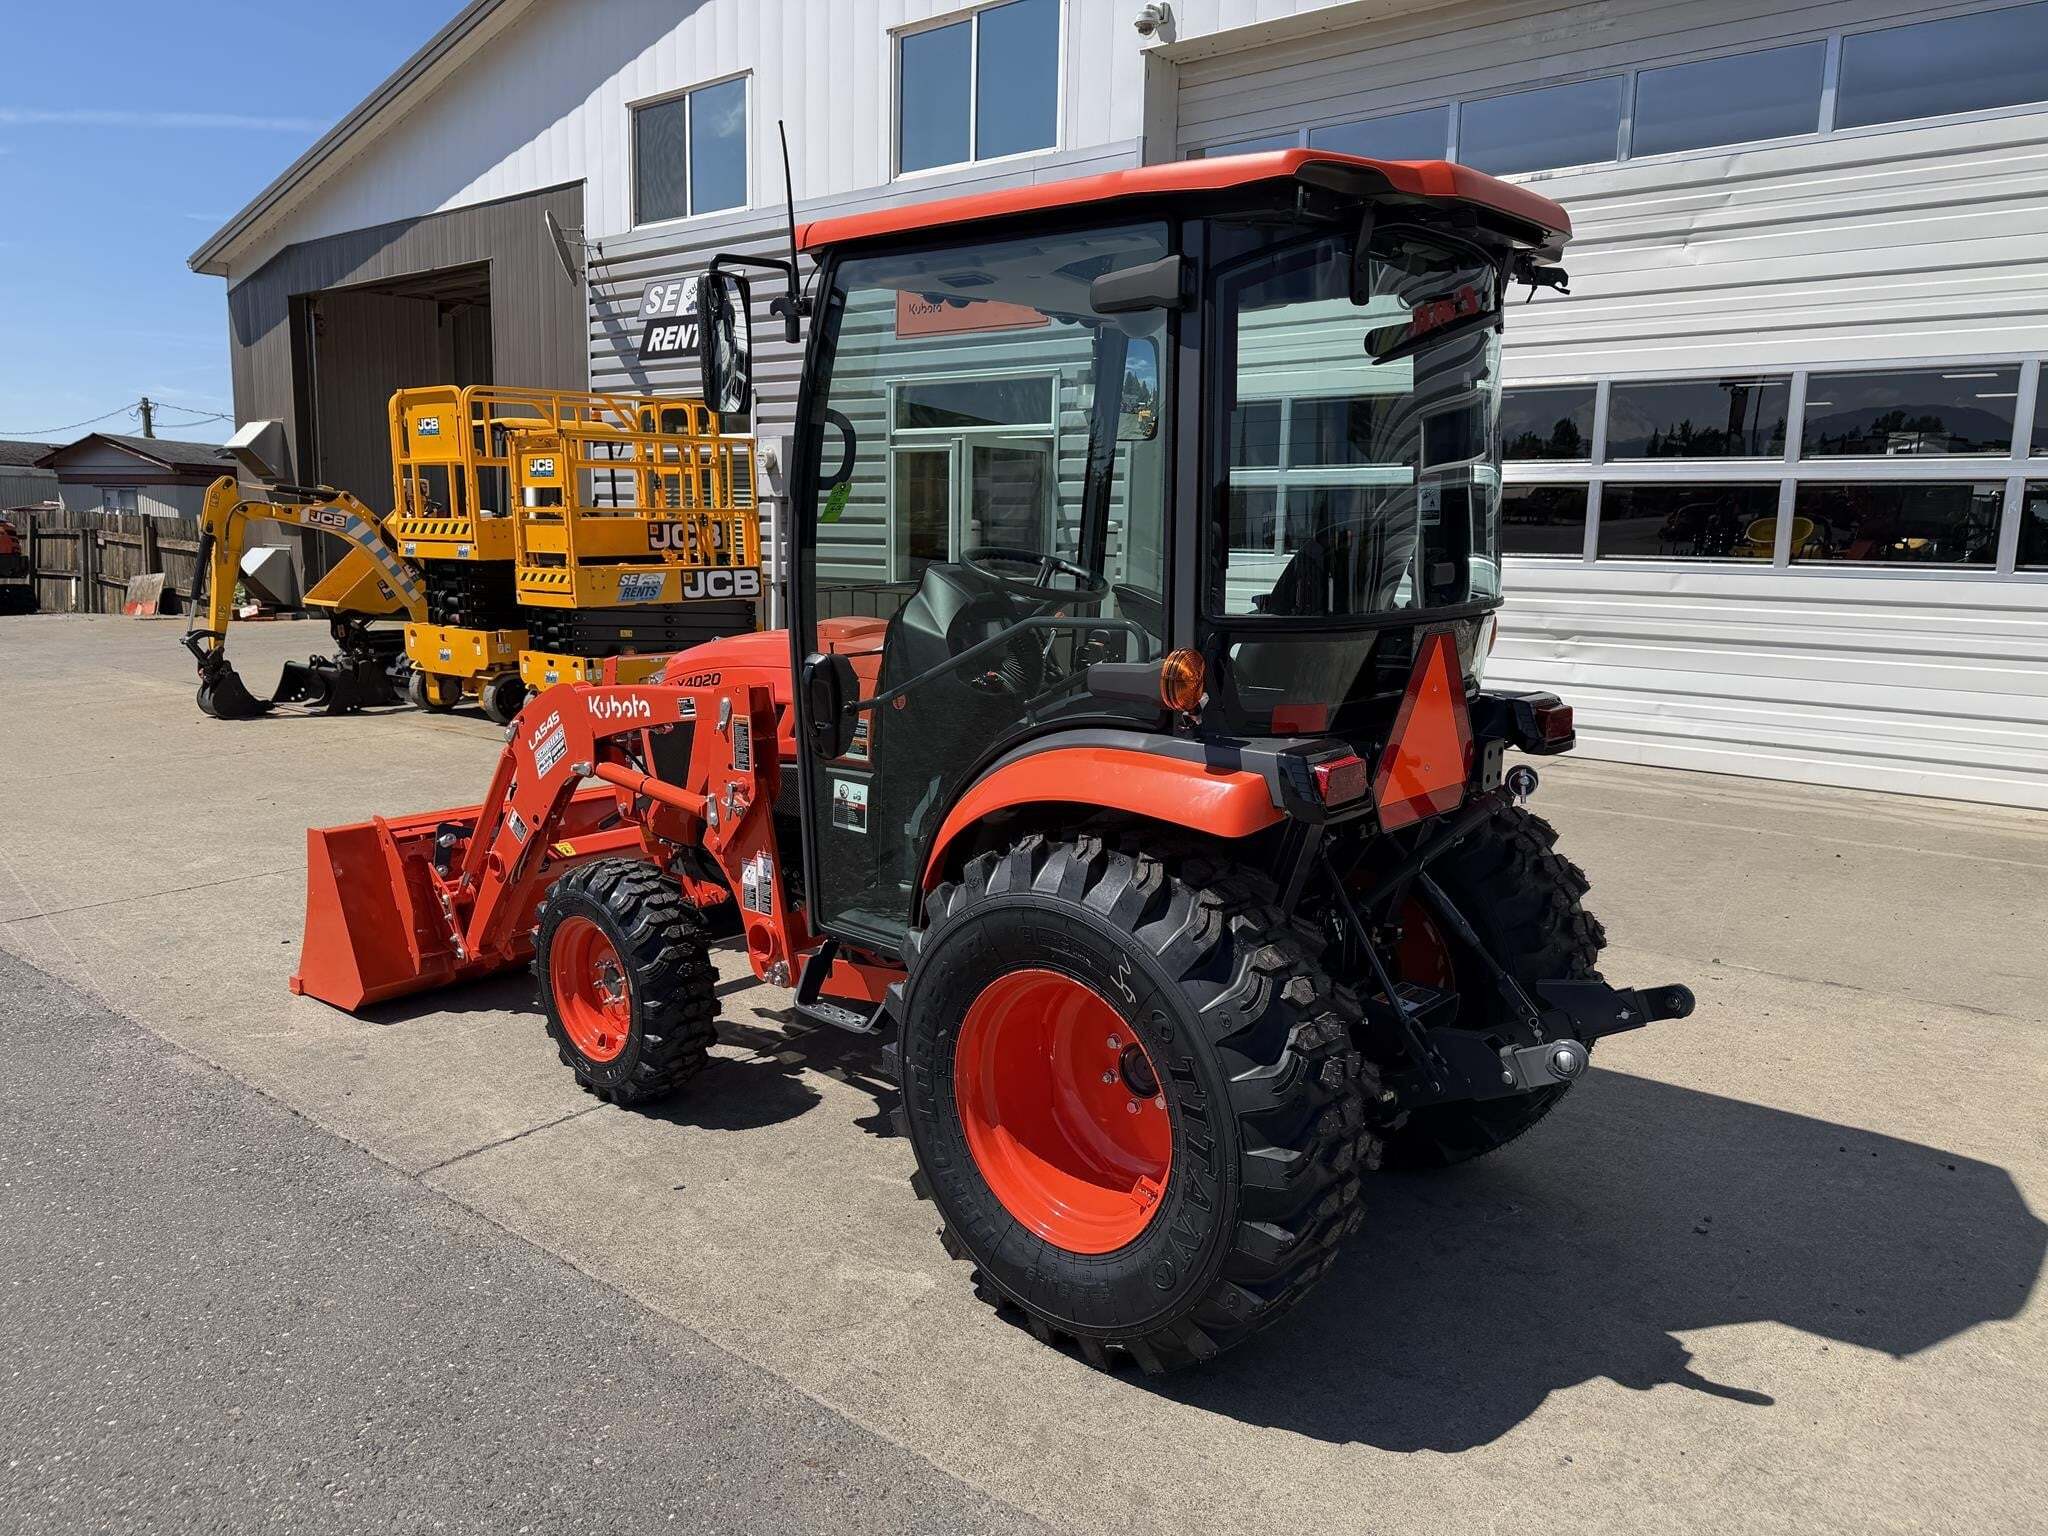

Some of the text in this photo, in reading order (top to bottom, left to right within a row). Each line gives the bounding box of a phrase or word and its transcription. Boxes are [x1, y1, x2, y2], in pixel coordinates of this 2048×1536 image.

[908, 303, 942, 315] Kubota
[647, 323, 699, 352] RENT
[417, 417, 439, 430] JCB
[530, 459, 554, 472] JCB
[310, 511, 346, 527] JCB
[622, 585, 658, 598] RENTS
[683, 570, 760, 599] JCB
[588, 694, 650, 719] Kubota
[528, 710, 560, 750] LA545
[1169, 1055, 1221, 1273] TITAN
